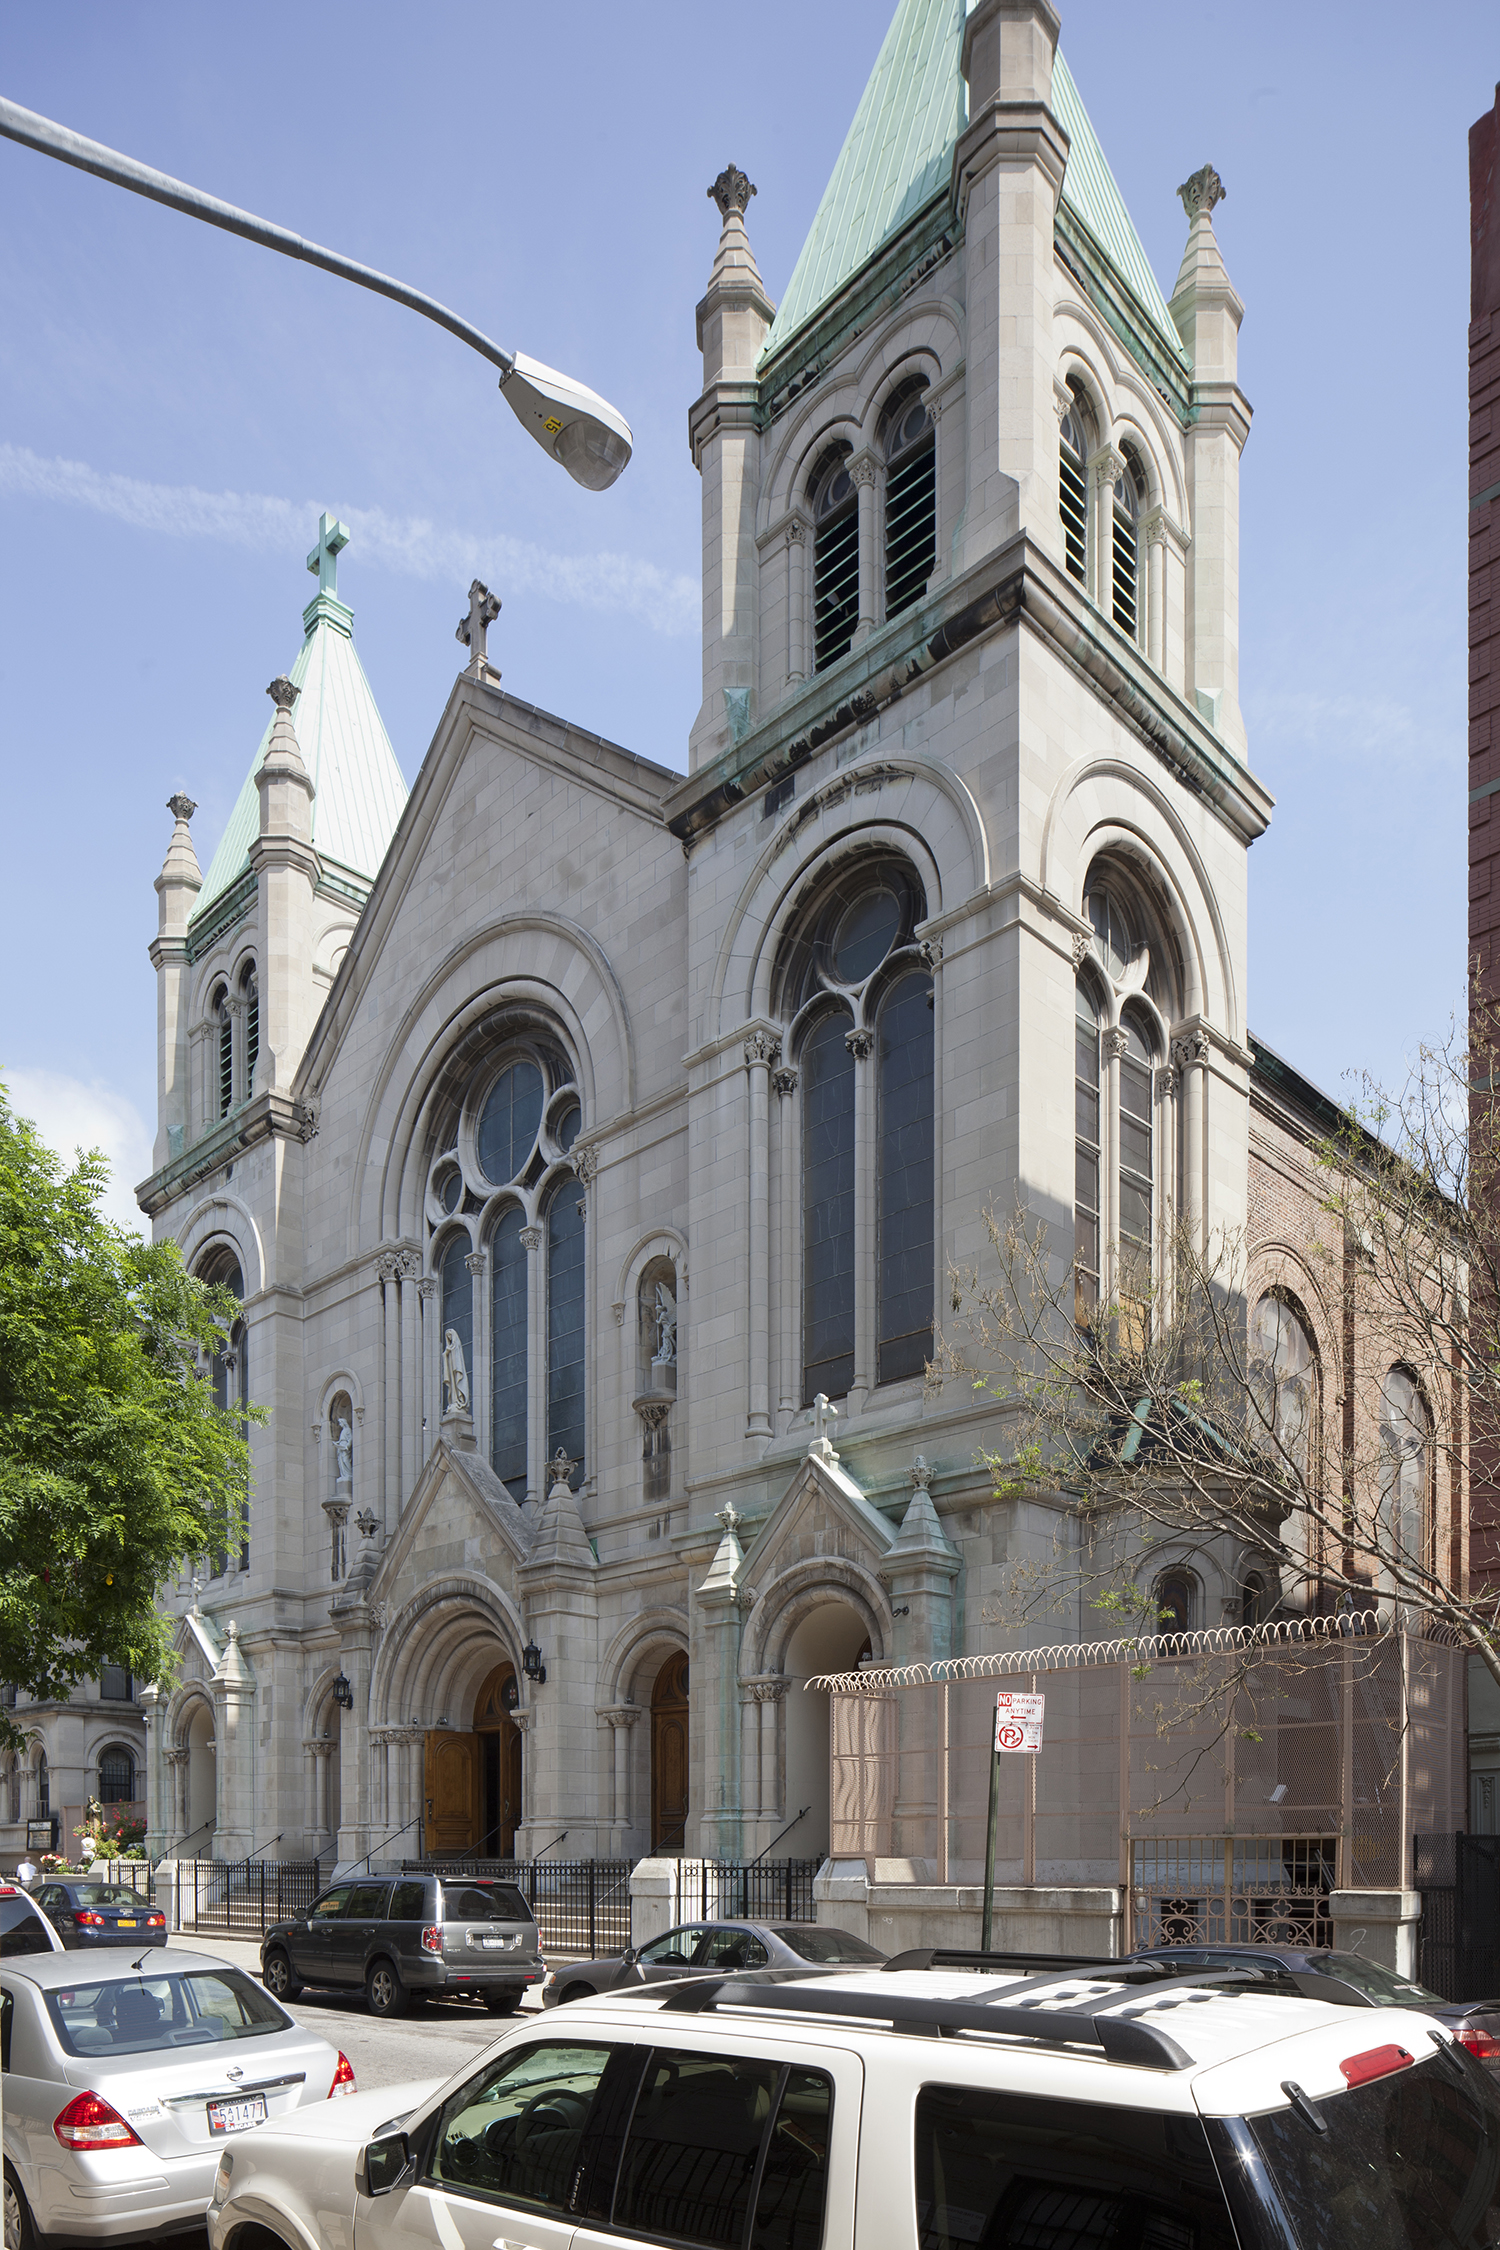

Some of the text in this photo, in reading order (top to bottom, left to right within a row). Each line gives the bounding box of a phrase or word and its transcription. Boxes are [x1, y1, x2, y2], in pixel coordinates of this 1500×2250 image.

[545, 419, 562, 434] 15
[999, 1694, 1042, 1706] NO PARKING
[1005, 1707, 1036, 1715] ANYTIME
